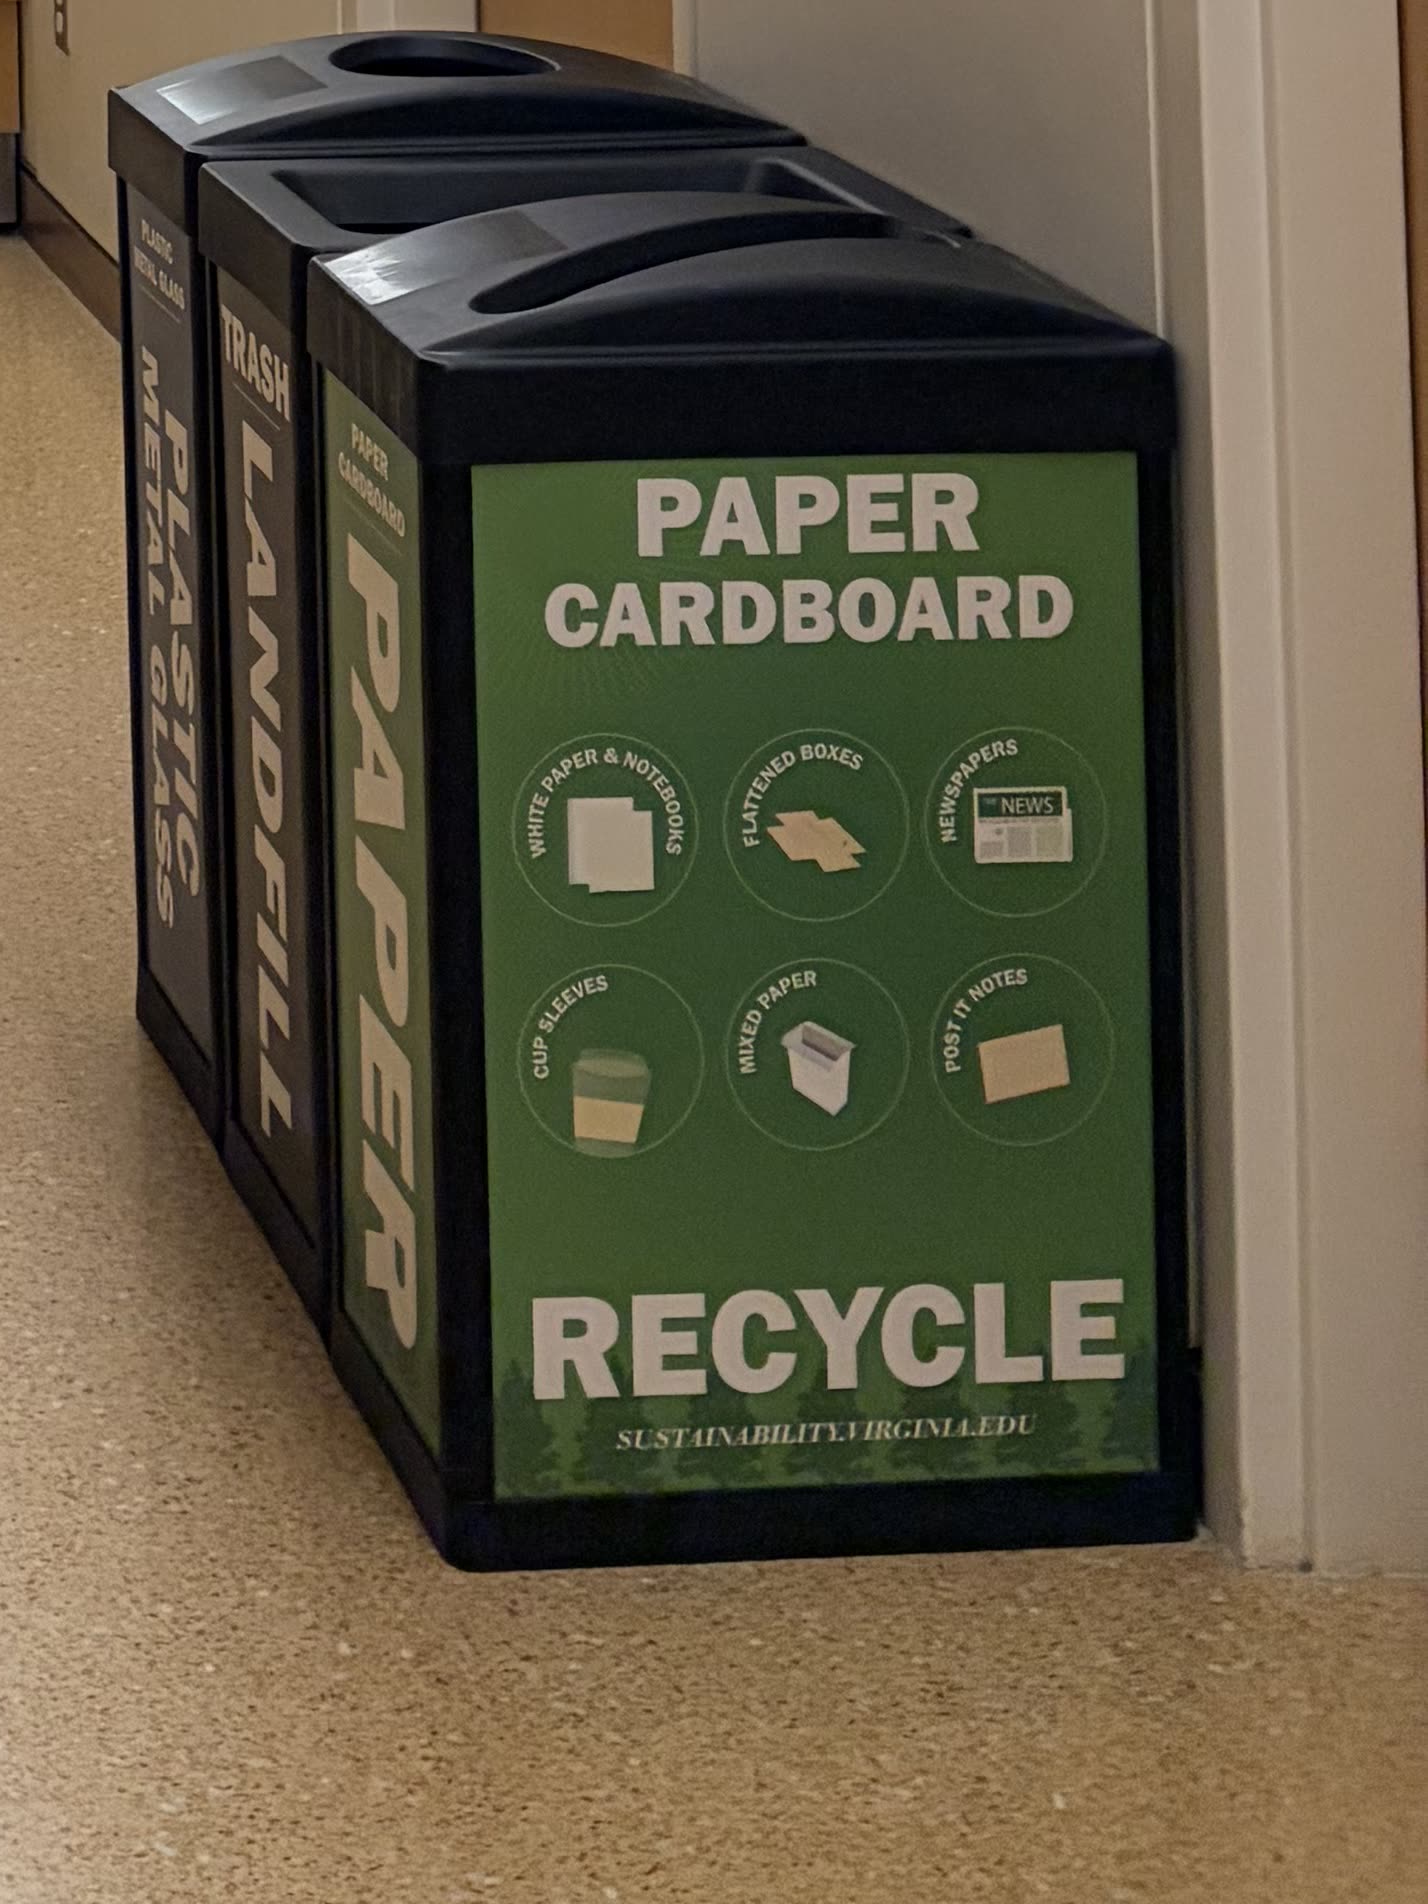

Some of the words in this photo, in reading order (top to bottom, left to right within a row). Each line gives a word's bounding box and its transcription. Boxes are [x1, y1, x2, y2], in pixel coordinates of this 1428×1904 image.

[141, 219, 173, 264] PLASTIC
[221, 303, 291, 422] TRASH
[142, 345, 164, 615] METAL
[338, 451, 406, 537] CARDBOARD
[351, 423, 389, 481] PAPER
[637, 472, 980, 557] PAPER
[165, 408, 201, 898] PLASTIC
[544, 574, 1074, 648] CARDBOARD
[150, 644, 174, 930] GLASS
[241, 419, 293, 1138] LANDFILL
[528, 793, 550, 859] WHITE
[541, 748, 598, 792] PAPER
[603, 747, 619, 765] &
[623, 751, 685, 856] NOTEBOOKS
[742, 751, 795, 848] FLATTENED
[800, 744, 863, 771] BOXES
[939, 739, 1018, 842] NEWSPAPERS
[1000, 796, 1054, 815] NEWS
[347, 531, 418, 1350] PAPER
[539, 974, 609, 1034] SLEEVES
[740, 1009, 763, 1075] MIXED
[757, 969, 817, 1011] PAPER
[952, 998, 970, 1020] IT
[966, 967, 1028, 1002] NOTES
[533, 1036, 551, 1080] CUP
[944, 1017, 962, 1073] POST
[532, 1278, 1126, 1400] RECYCLE
[615, 1414, 1037, 1451] SUSTAINABILITY.VIRGINIA.EDU
